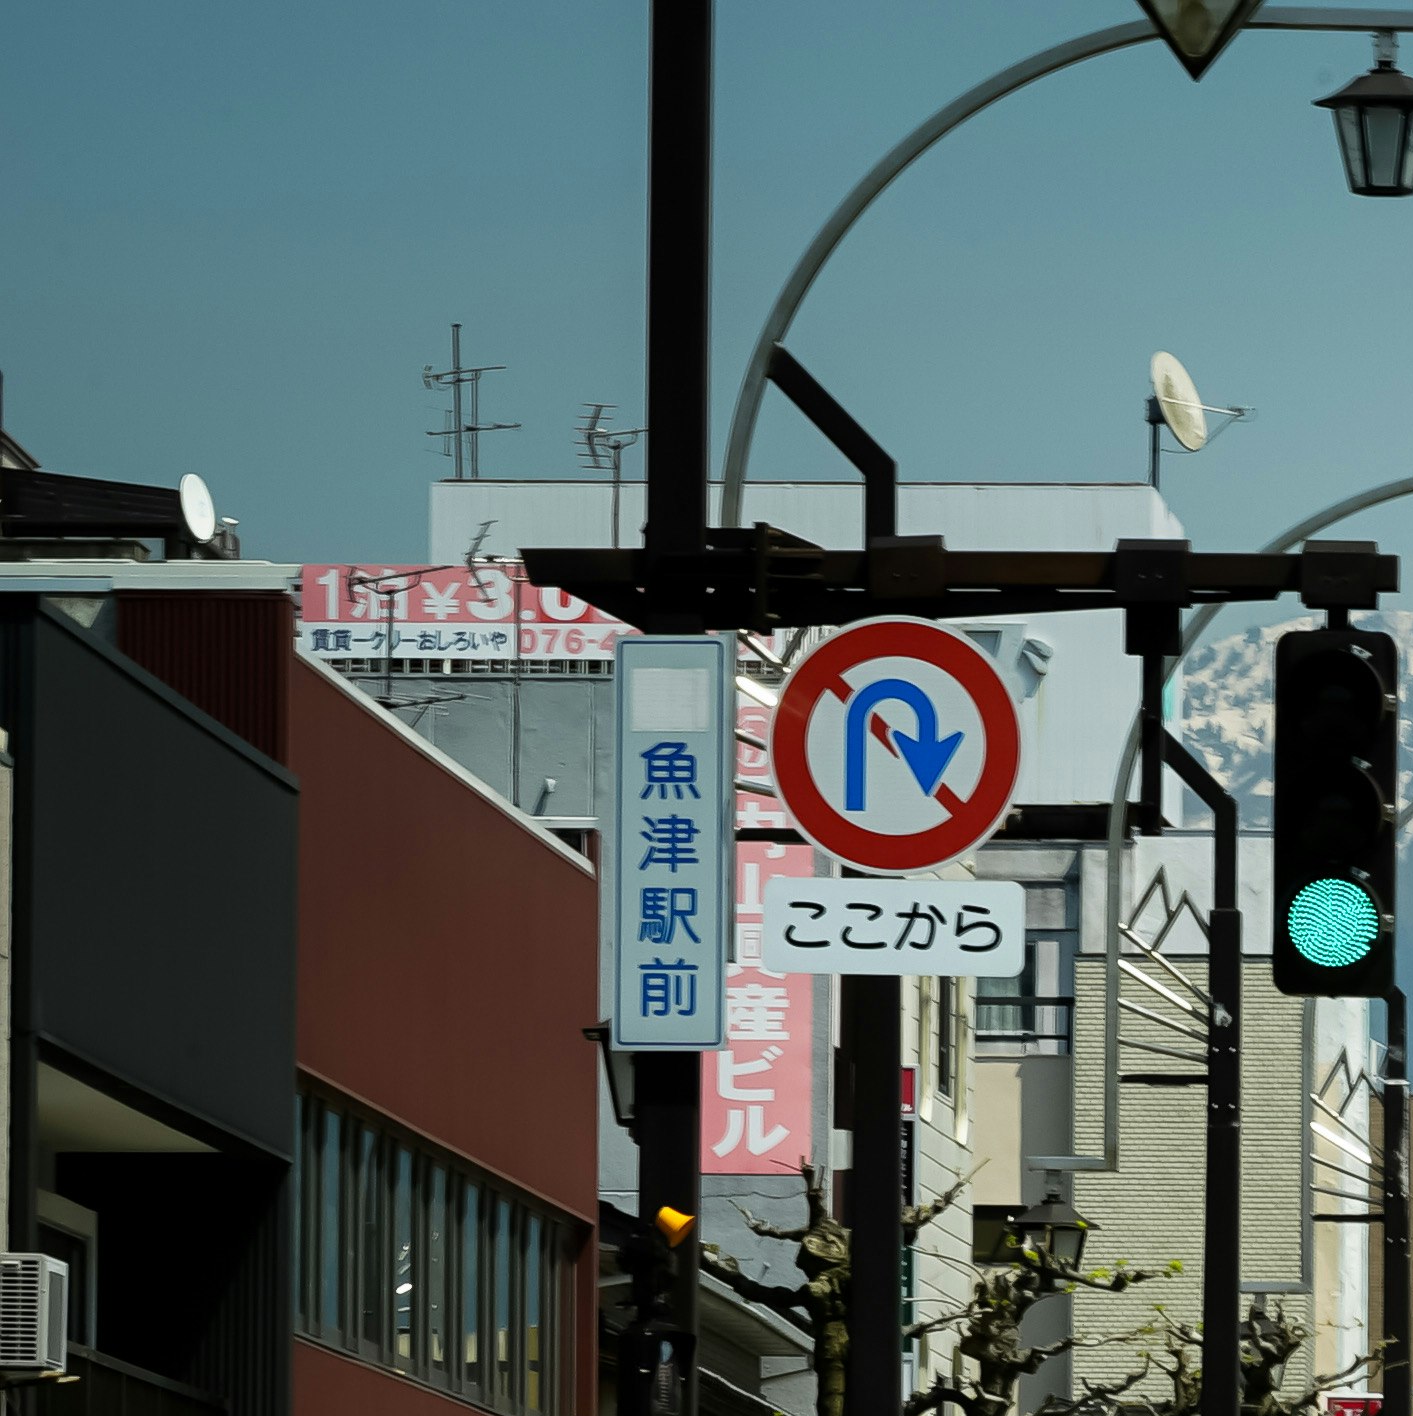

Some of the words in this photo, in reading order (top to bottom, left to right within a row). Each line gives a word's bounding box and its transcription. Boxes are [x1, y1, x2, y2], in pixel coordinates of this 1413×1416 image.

[638, 741, 700, 1018] 魚津駅前
[784, 901, 1003, 953] ここから
